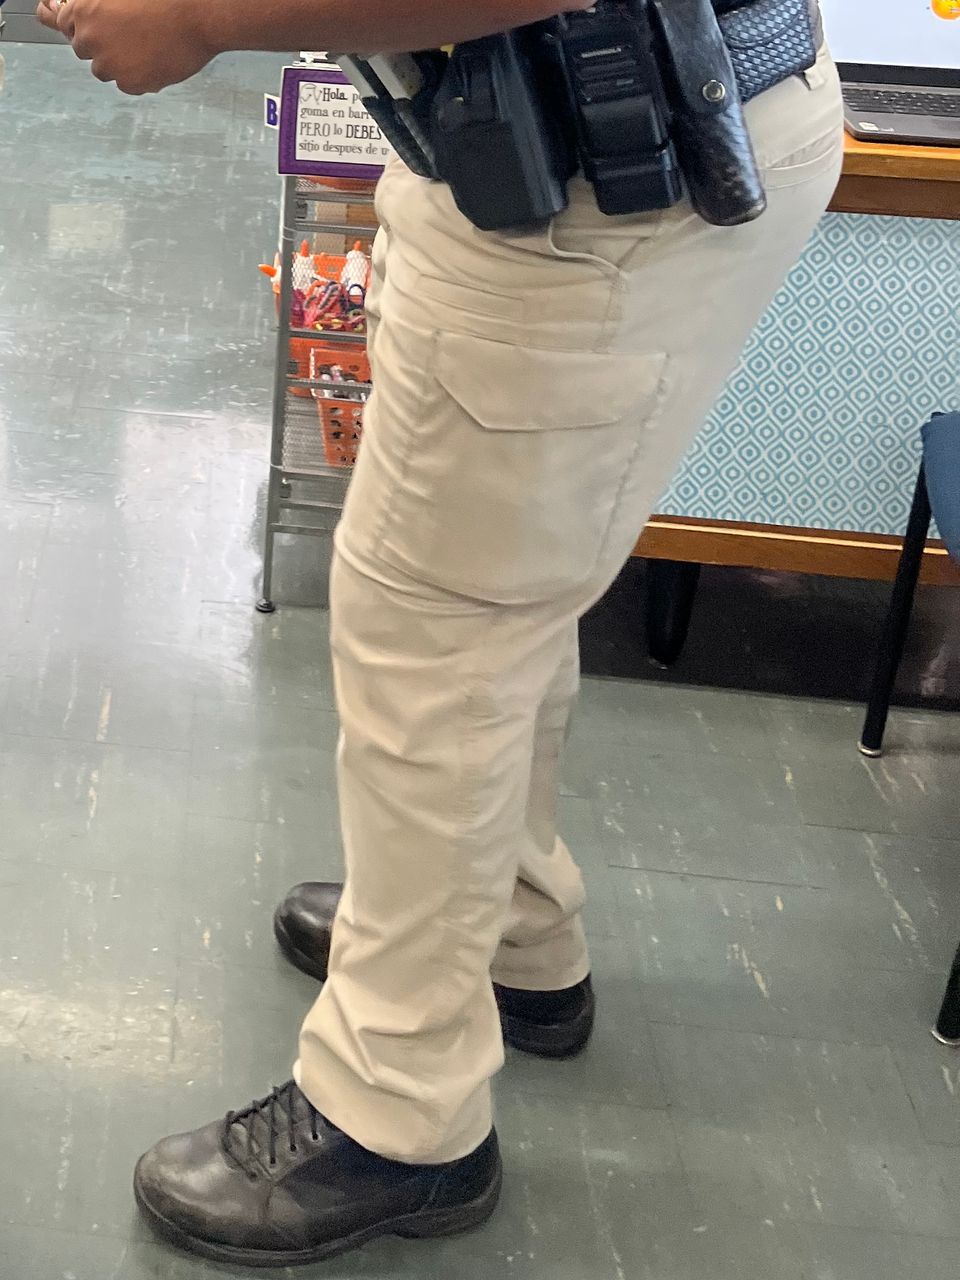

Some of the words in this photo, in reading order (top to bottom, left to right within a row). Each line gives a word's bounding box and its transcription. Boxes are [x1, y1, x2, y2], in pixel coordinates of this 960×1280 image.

[266, 97, 278, 127] B
[299, 106, 329, 119] goma
[332, 108, 345, 119] en
[348, 106, 371, 120] barr
[299, 121, 330, 137] PERO
[333, 123, 343, 136] lo
[345, 123, 382, 140] DEBES
[299, 139, 320, 153] sitio
[365, 142, 378, 156] de
